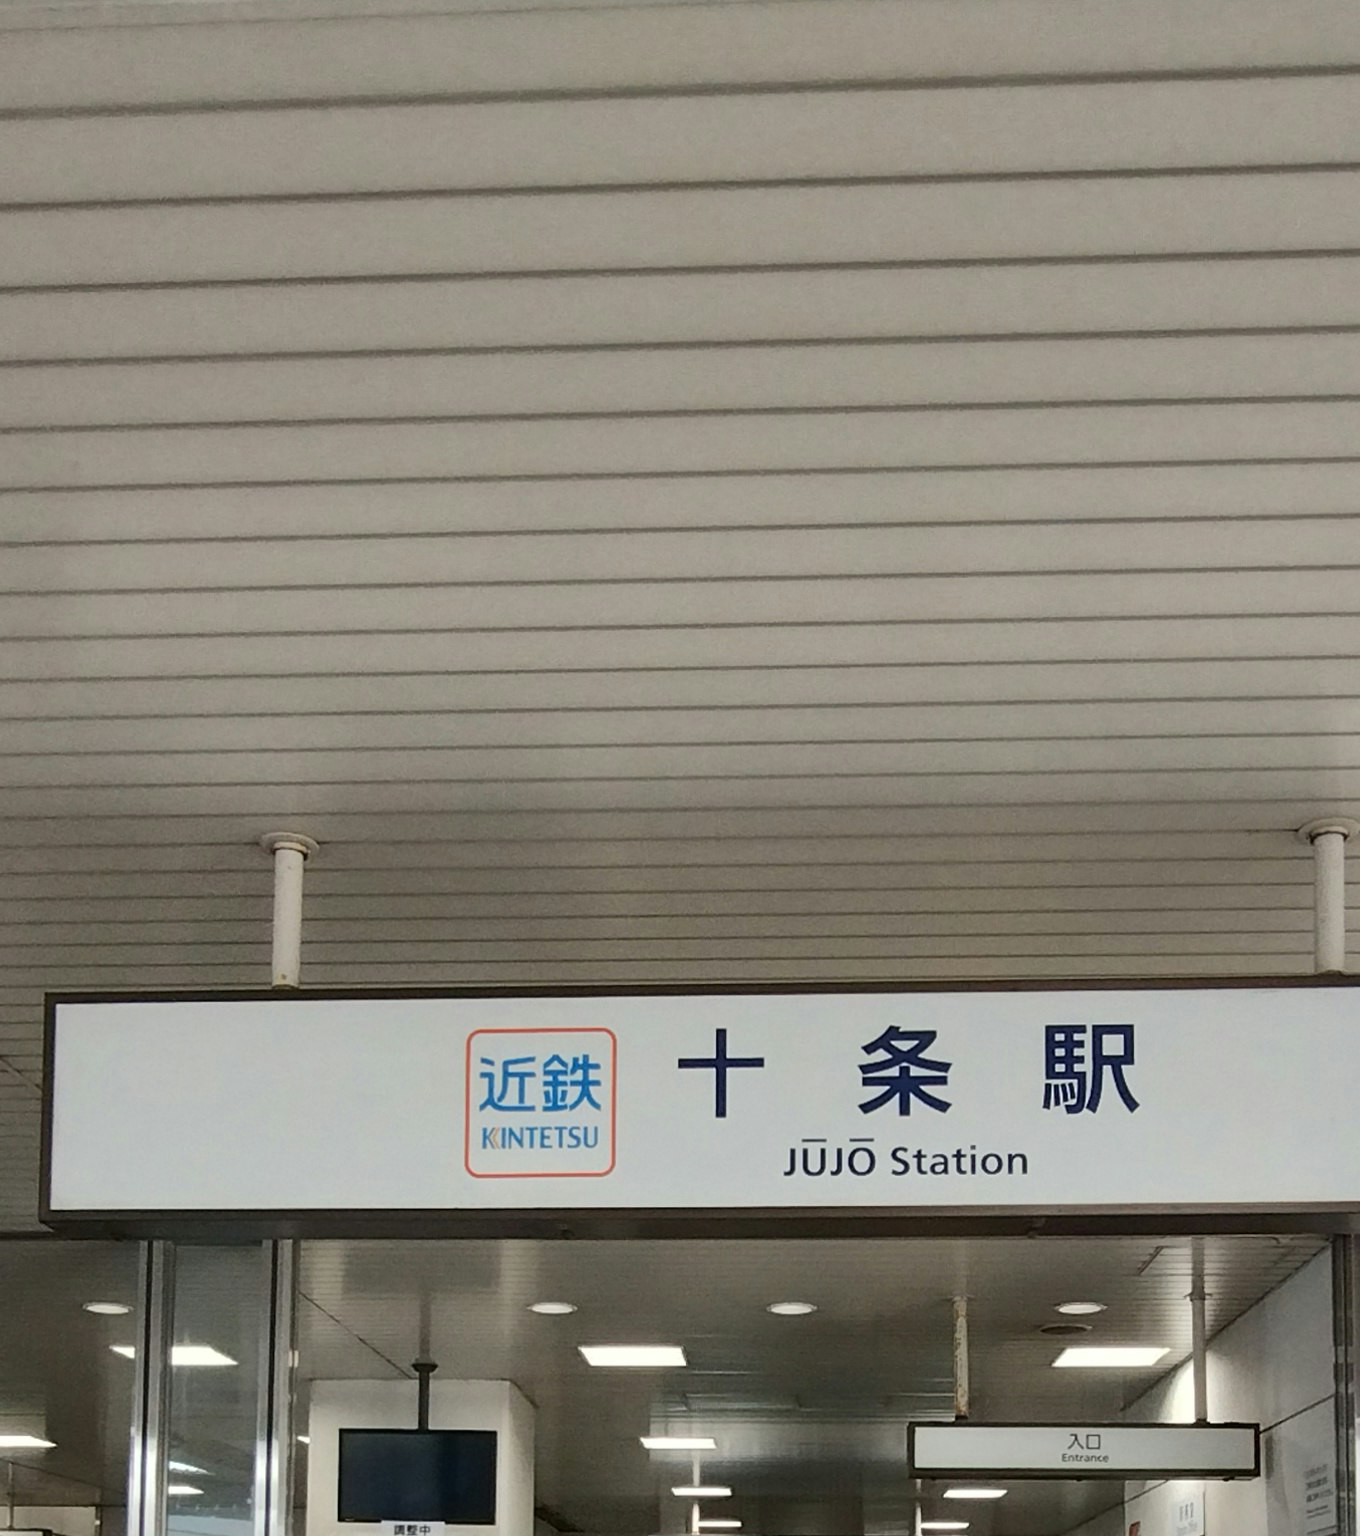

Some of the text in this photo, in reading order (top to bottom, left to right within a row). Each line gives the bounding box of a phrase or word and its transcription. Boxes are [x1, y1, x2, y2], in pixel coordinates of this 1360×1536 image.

[677, 1024, 1142, 1118] 十条駅
[478, 1054, 603, 1113] 近鉄
[481, 1126, 599, 1150] KINTETSU
[784, 1138, 1030, 1177] JŪJŌ Station
[1067, 1433, 1101, 1450] 入口
[1061, 1452, 1110, 1463] Entrance
[393, 1524, 431, 1536] 調整中
